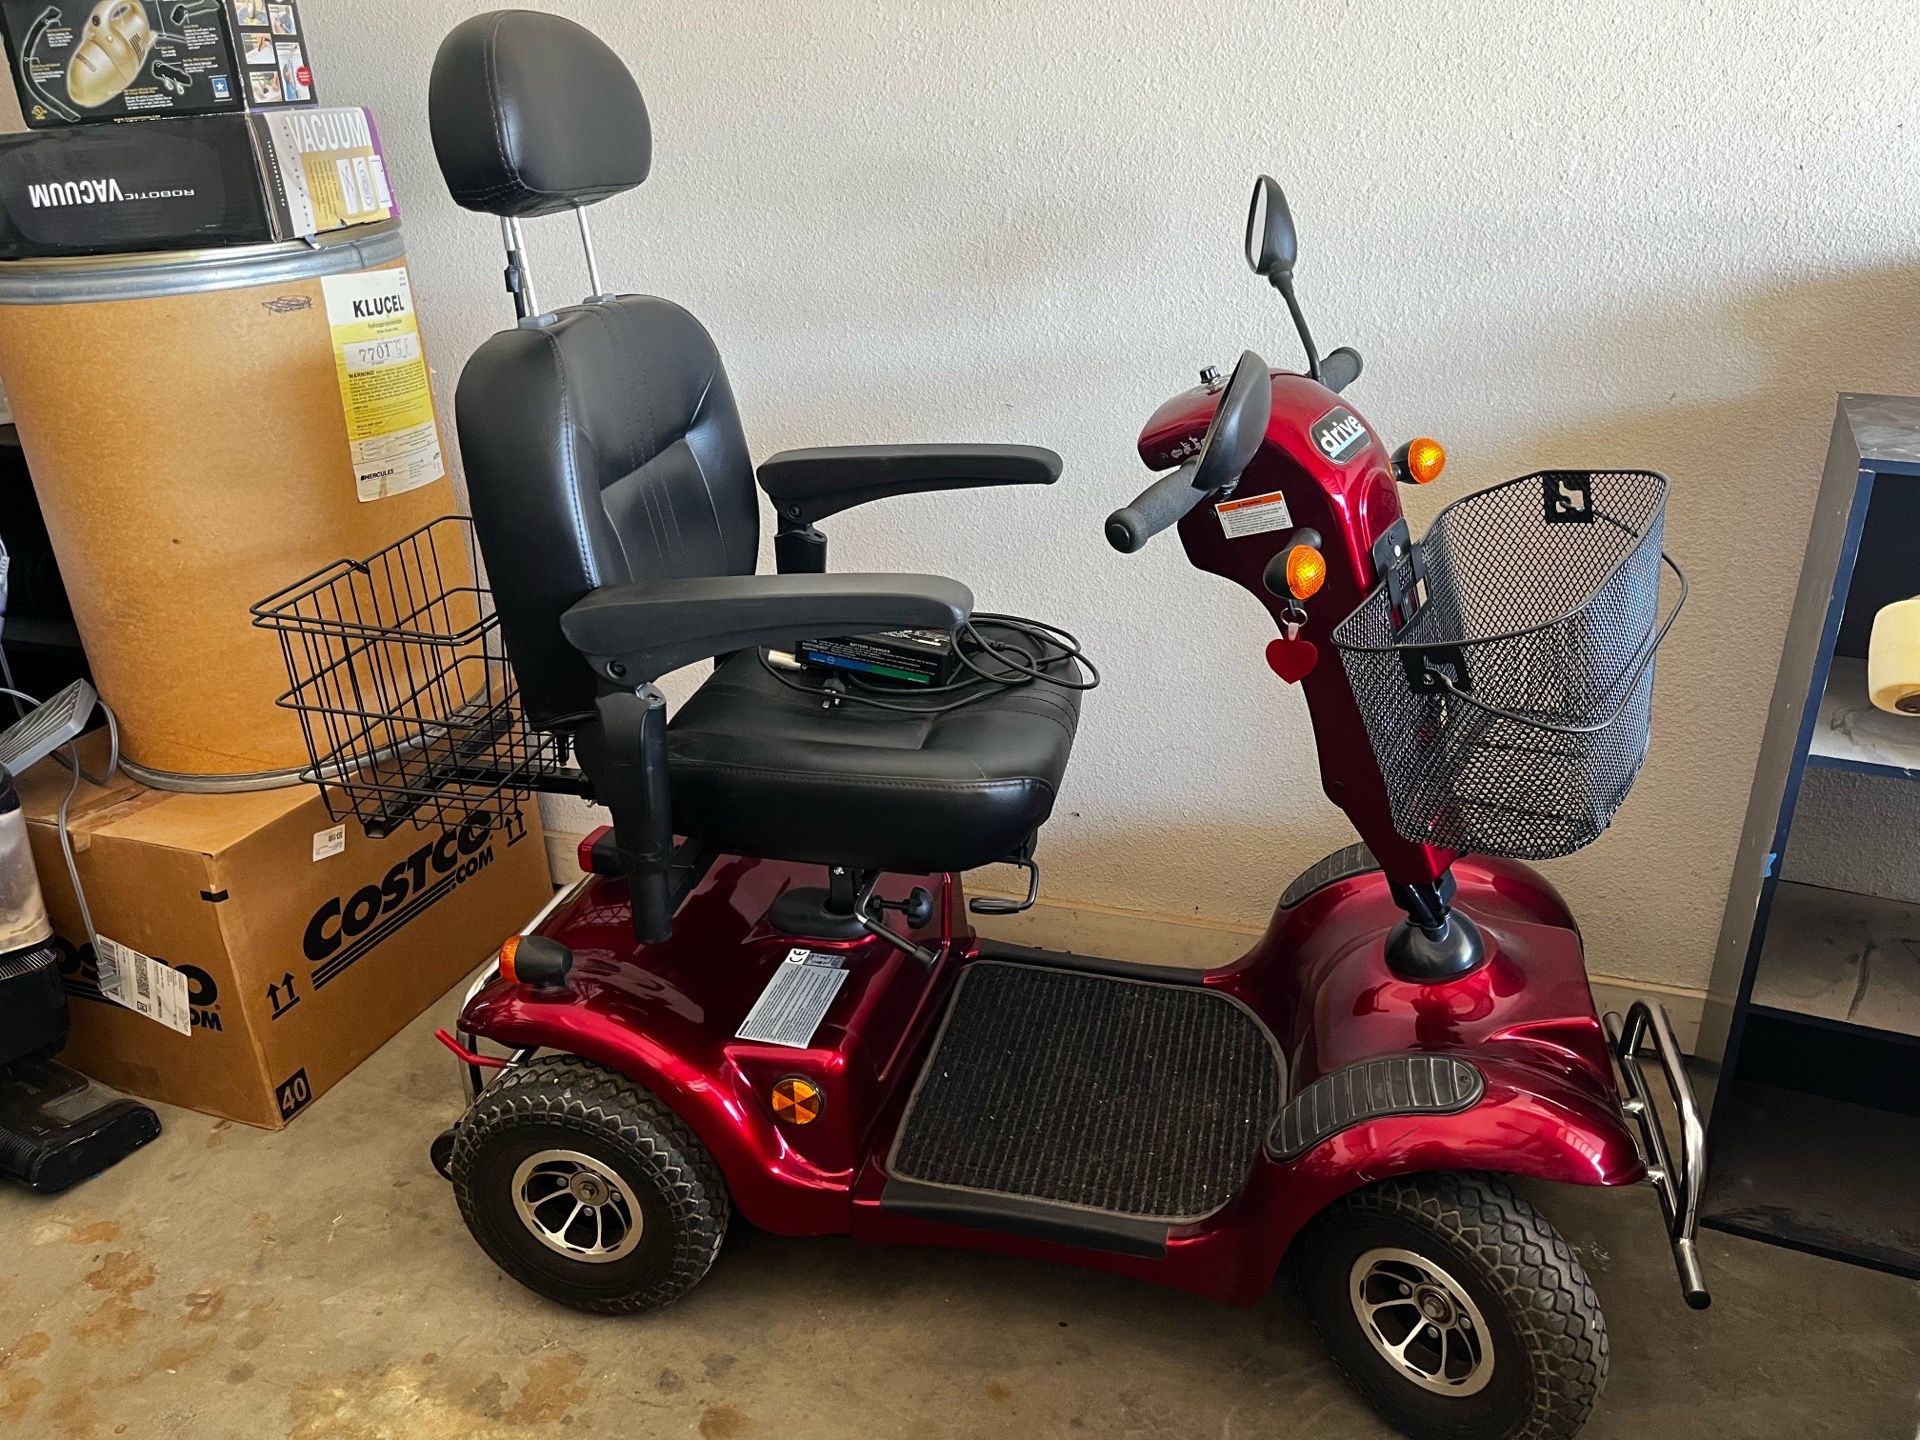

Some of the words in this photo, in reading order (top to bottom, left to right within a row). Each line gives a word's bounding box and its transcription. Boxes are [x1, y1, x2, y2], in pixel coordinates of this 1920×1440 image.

[286, 112, 368, 153] VACUUM
[28, 178, 125, 208] VACUUM
[124, 189, 194, 201] ROBOTIC
[352, 294, 405, 318] KLUCEL
[1320, 415, 1363, 453] drive
[303, 810, 492, 961] COSTCO
[282, 1077, 307, 1111] 40
